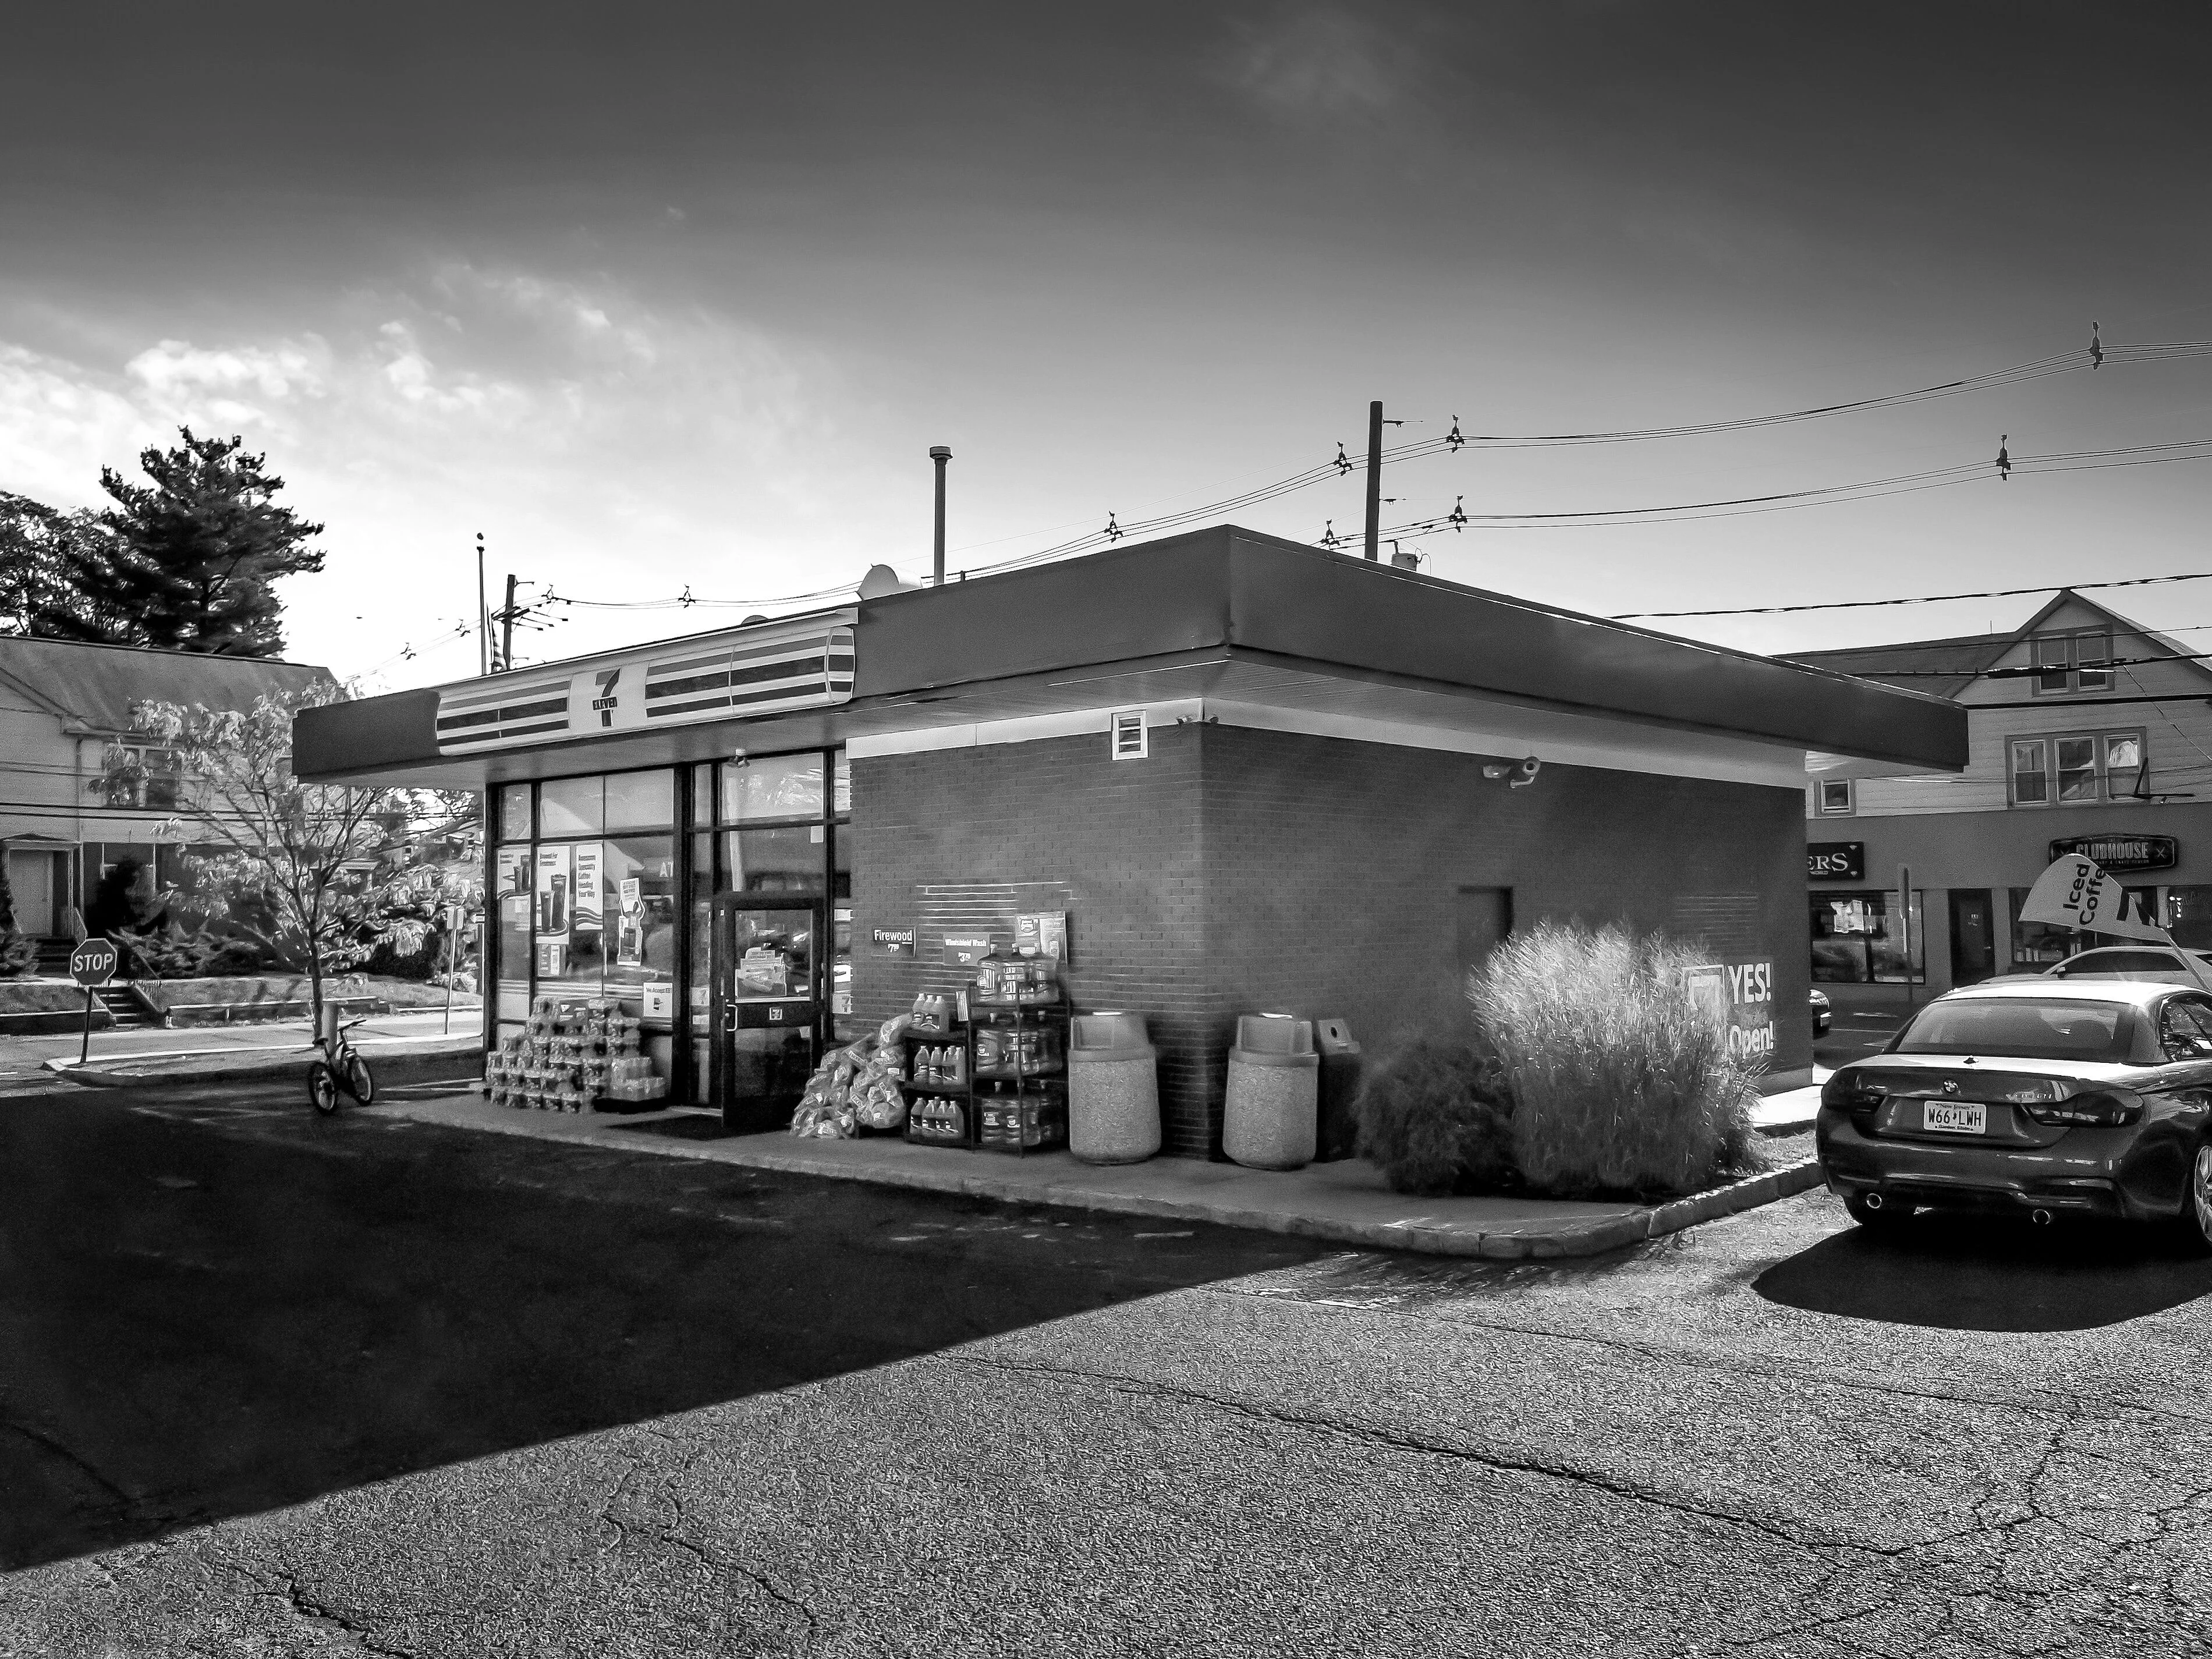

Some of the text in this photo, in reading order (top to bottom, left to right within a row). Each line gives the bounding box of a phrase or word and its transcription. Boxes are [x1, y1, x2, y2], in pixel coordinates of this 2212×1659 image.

[595, 668, 621, 727] 7
[2076, 842, 2149, 860] CLUBHOUSE
[2062, 863, 2091, 910] Iced
[874, 929, 912, 941] Firewood
[972, 939, 987, 947] Wash
[74, 953, 114, 972] STOP
[1727, 962, 1771, 1005] YES!
[1729, 1020, 1774, 1059] Open!
